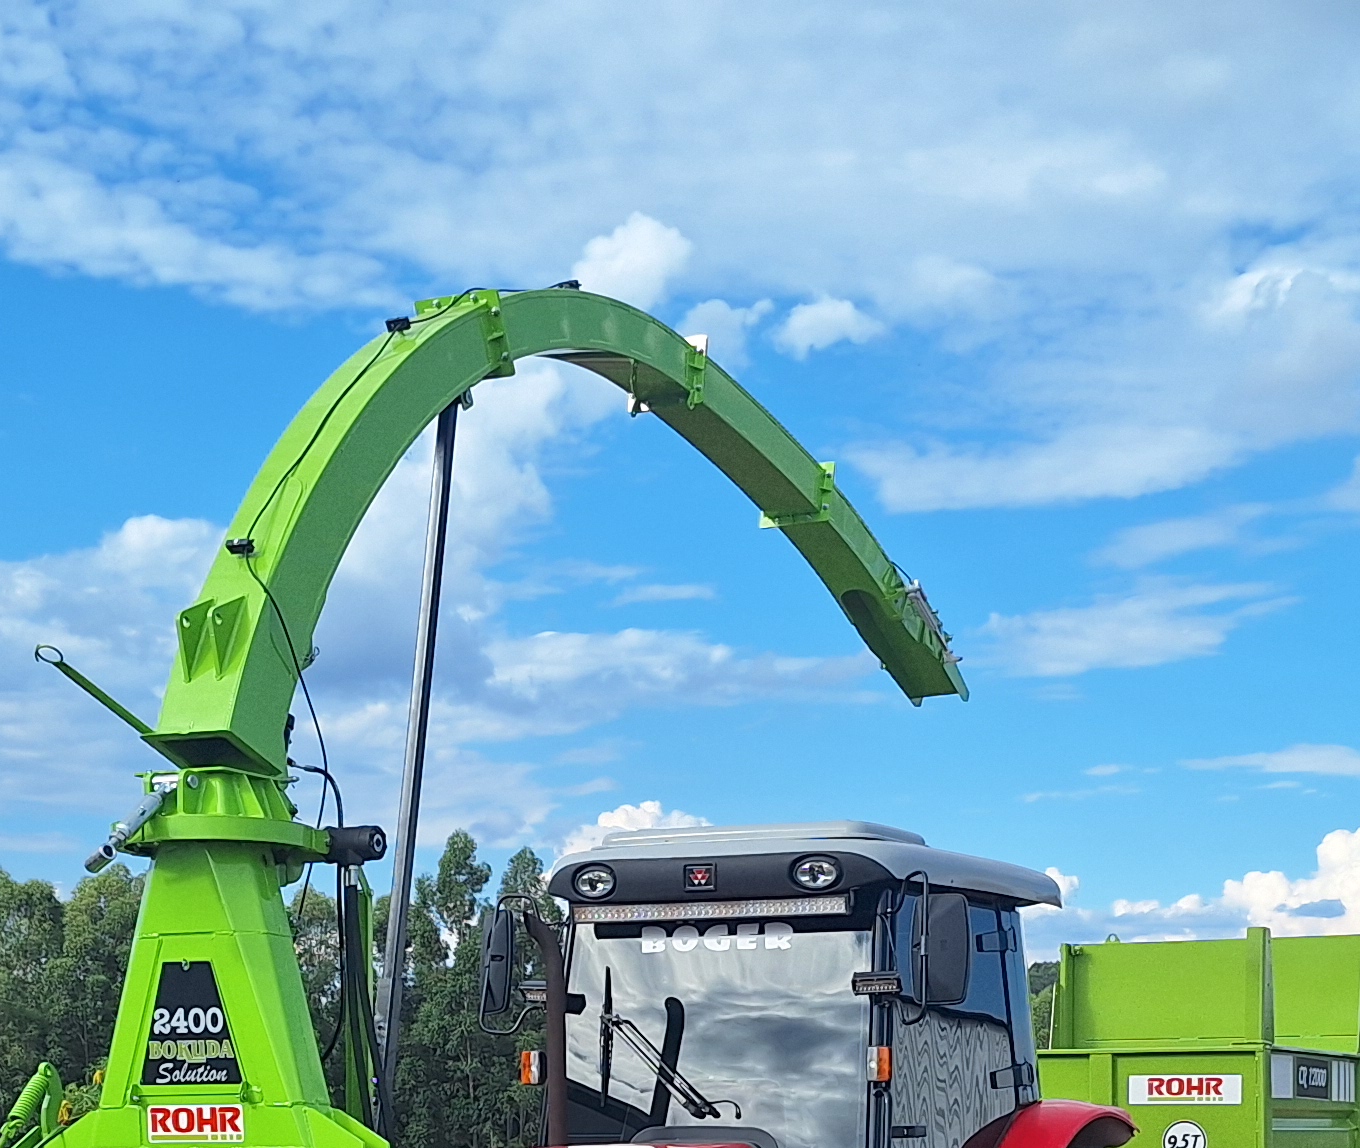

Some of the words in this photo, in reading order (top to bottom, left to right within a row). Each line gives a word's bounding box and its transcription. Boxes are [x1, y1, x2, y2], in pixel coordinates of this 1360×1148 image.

[153, 1006, 224, 1035] 2400
[148, 1039, 235, 1063] BOKUDA
[155, 1062, 228, 1084] Solution
[1147, 1077, 1224, 1096] ROHR
[150, 1106, 242, 1133] ROHR
